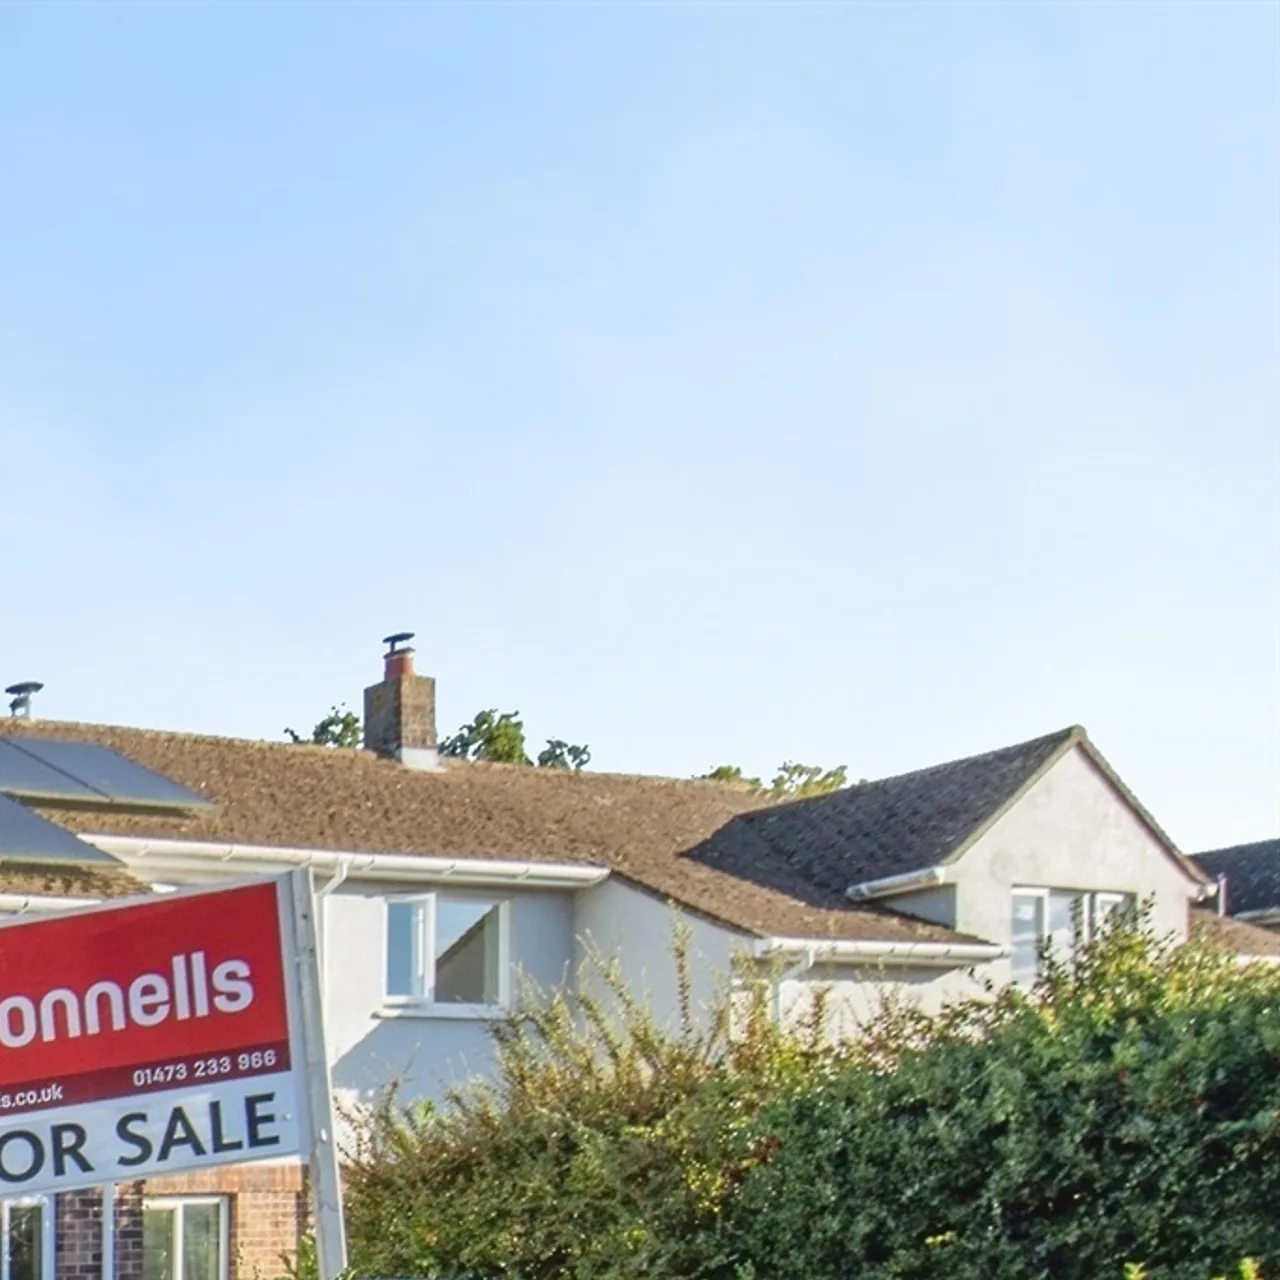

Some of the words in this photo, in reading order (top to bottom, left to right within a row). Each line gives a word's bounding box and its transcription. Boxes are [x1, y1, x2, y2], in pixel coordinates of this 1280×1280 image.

[132, 1063, 188, 1087] 01473
[194, 1056, 232, 1078] 233
[237, 1049, 277, 1071] 966
[116, 1092, 281, 1167] SALE
